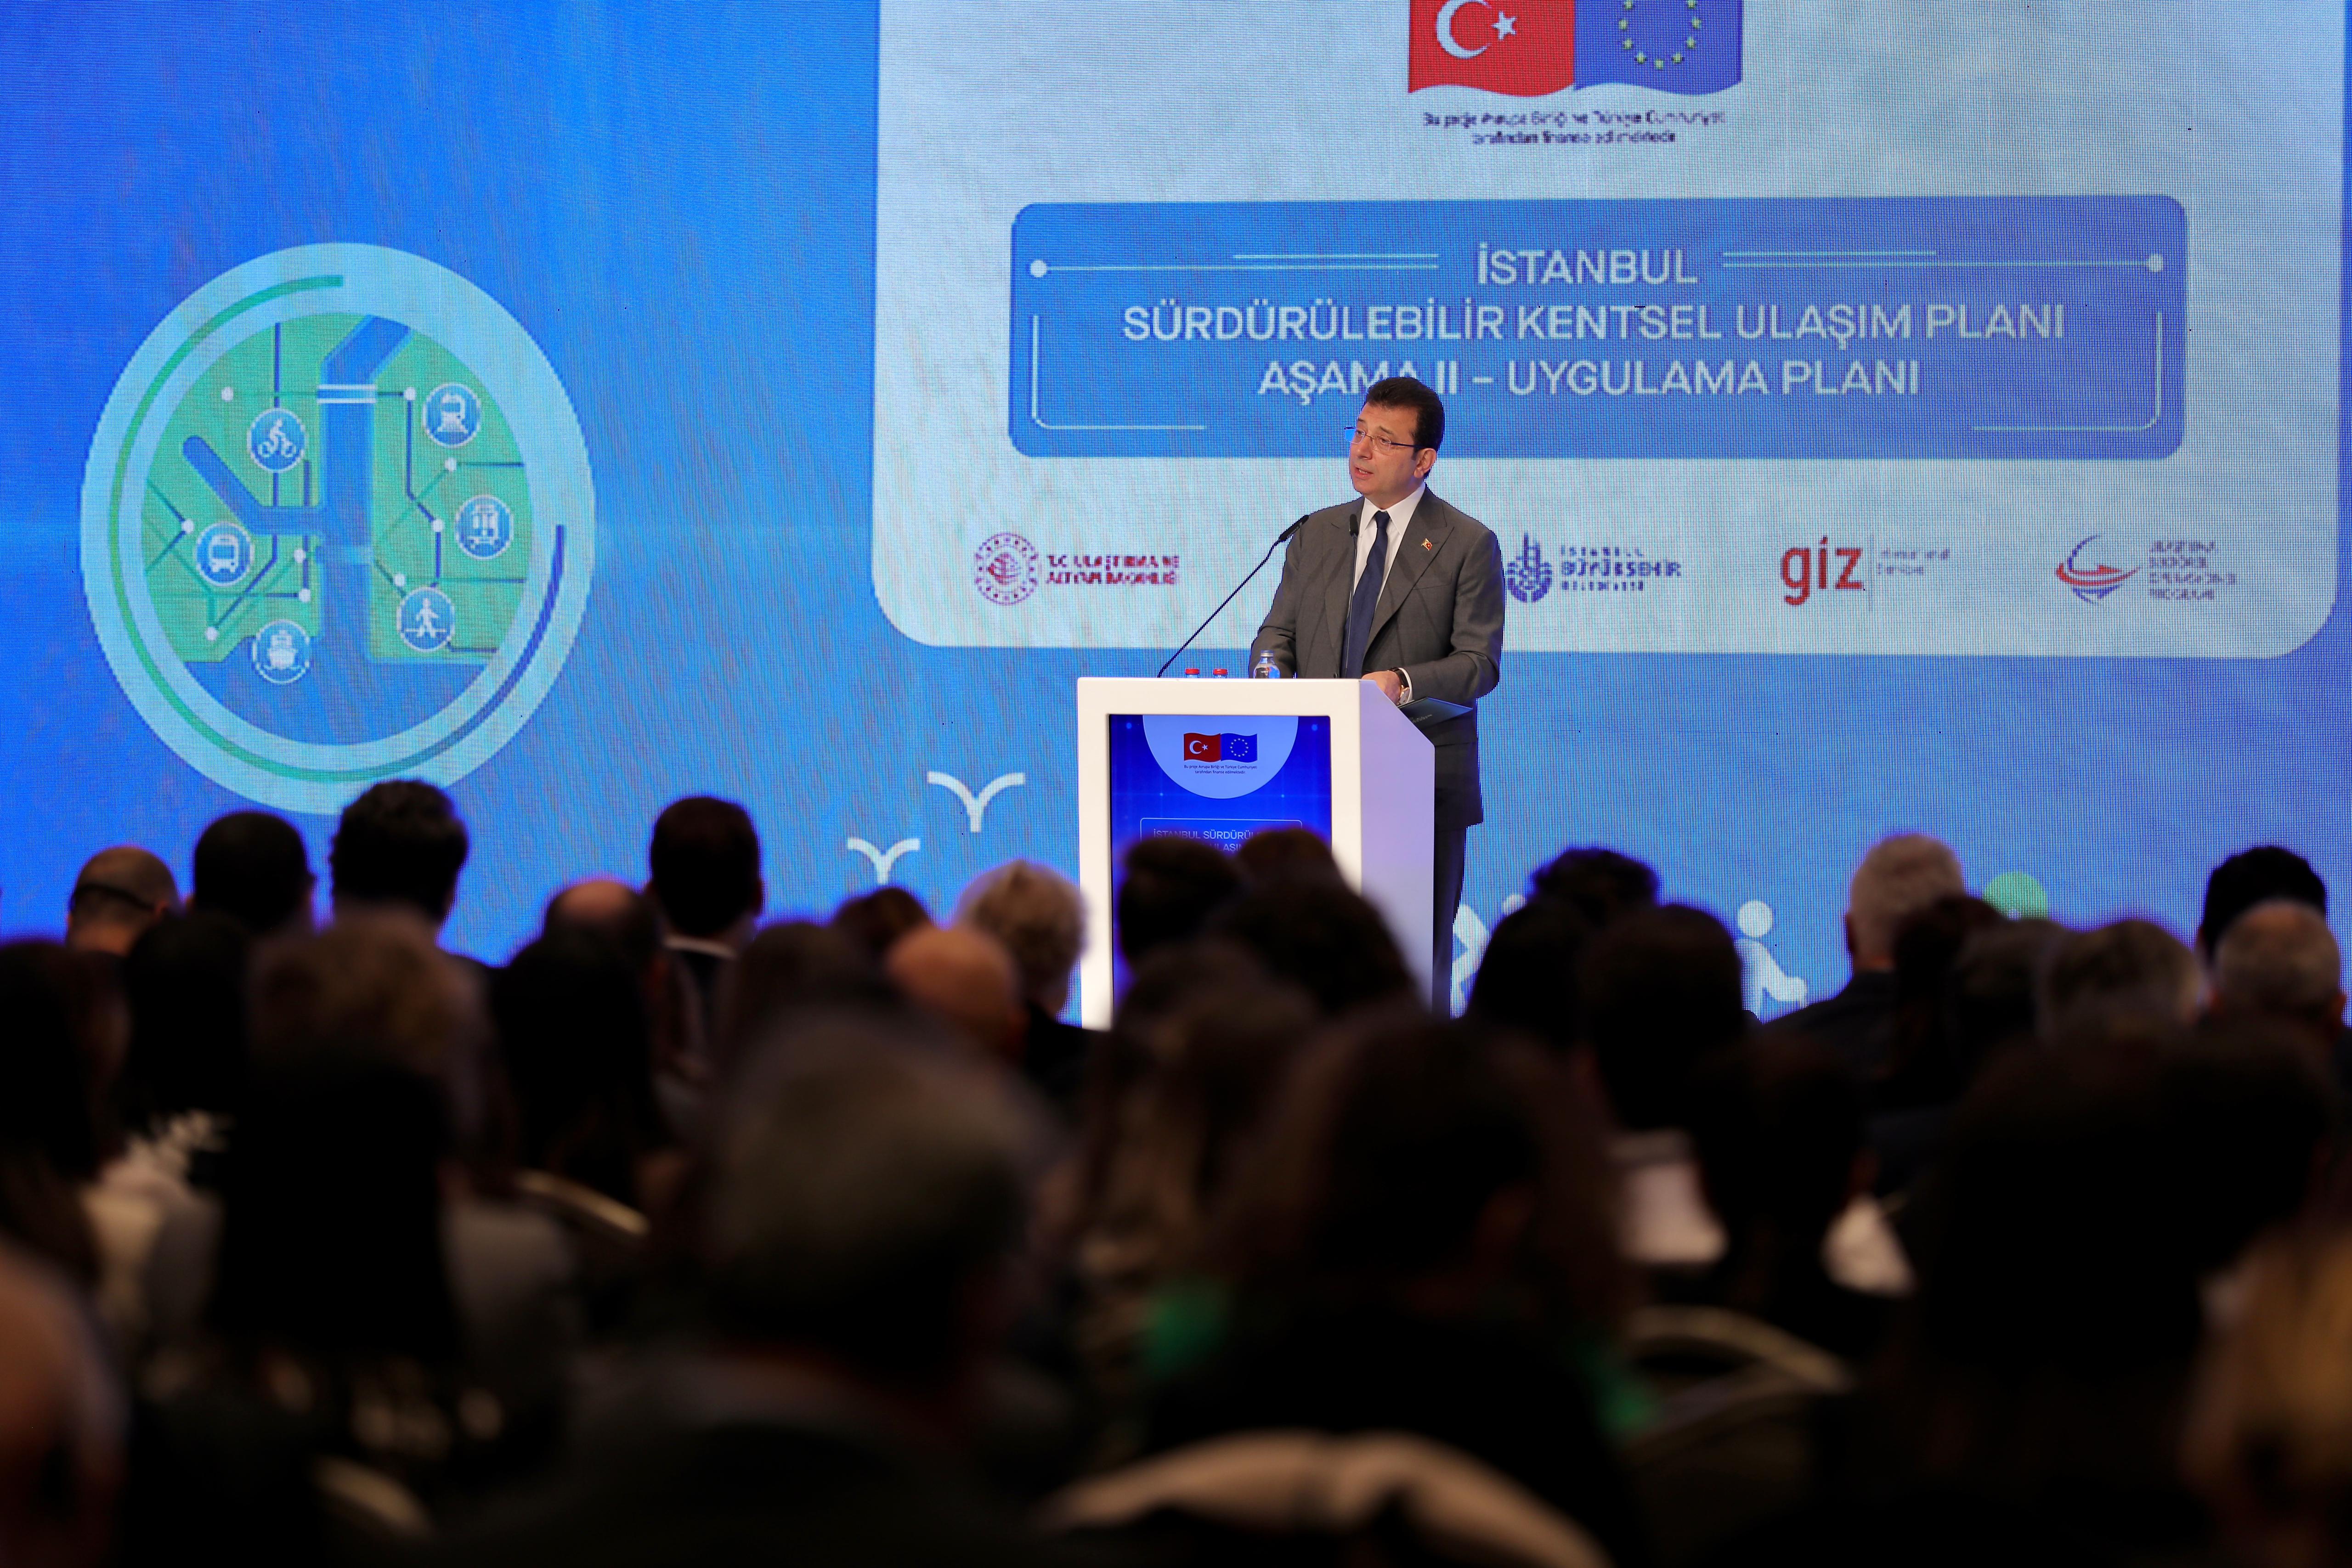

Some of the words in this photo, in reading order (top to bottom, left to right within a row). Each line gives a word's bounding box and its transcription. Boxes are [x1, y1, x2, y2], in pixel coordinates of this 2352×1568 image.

[1477, 242, 1697, 285] İSTANBUL
[1123, 298, 1504, 342] SÜRDÜRÜLEBİLİR
[1517, 304, 1721, 340] KENTSEL
[1736, 303, 1912, 351] ULAŞIM
[1925, 303, 2064, 339] PLANI
[1436, 360, 1458, 395] II
[1508, 360, 1769, 395] UYGULAMA
[1781, 360, 1919, 395] PLANI
[1780, 536, 1863, 606] giz
[1153, 828, 1201, 839] İSTANBUL
